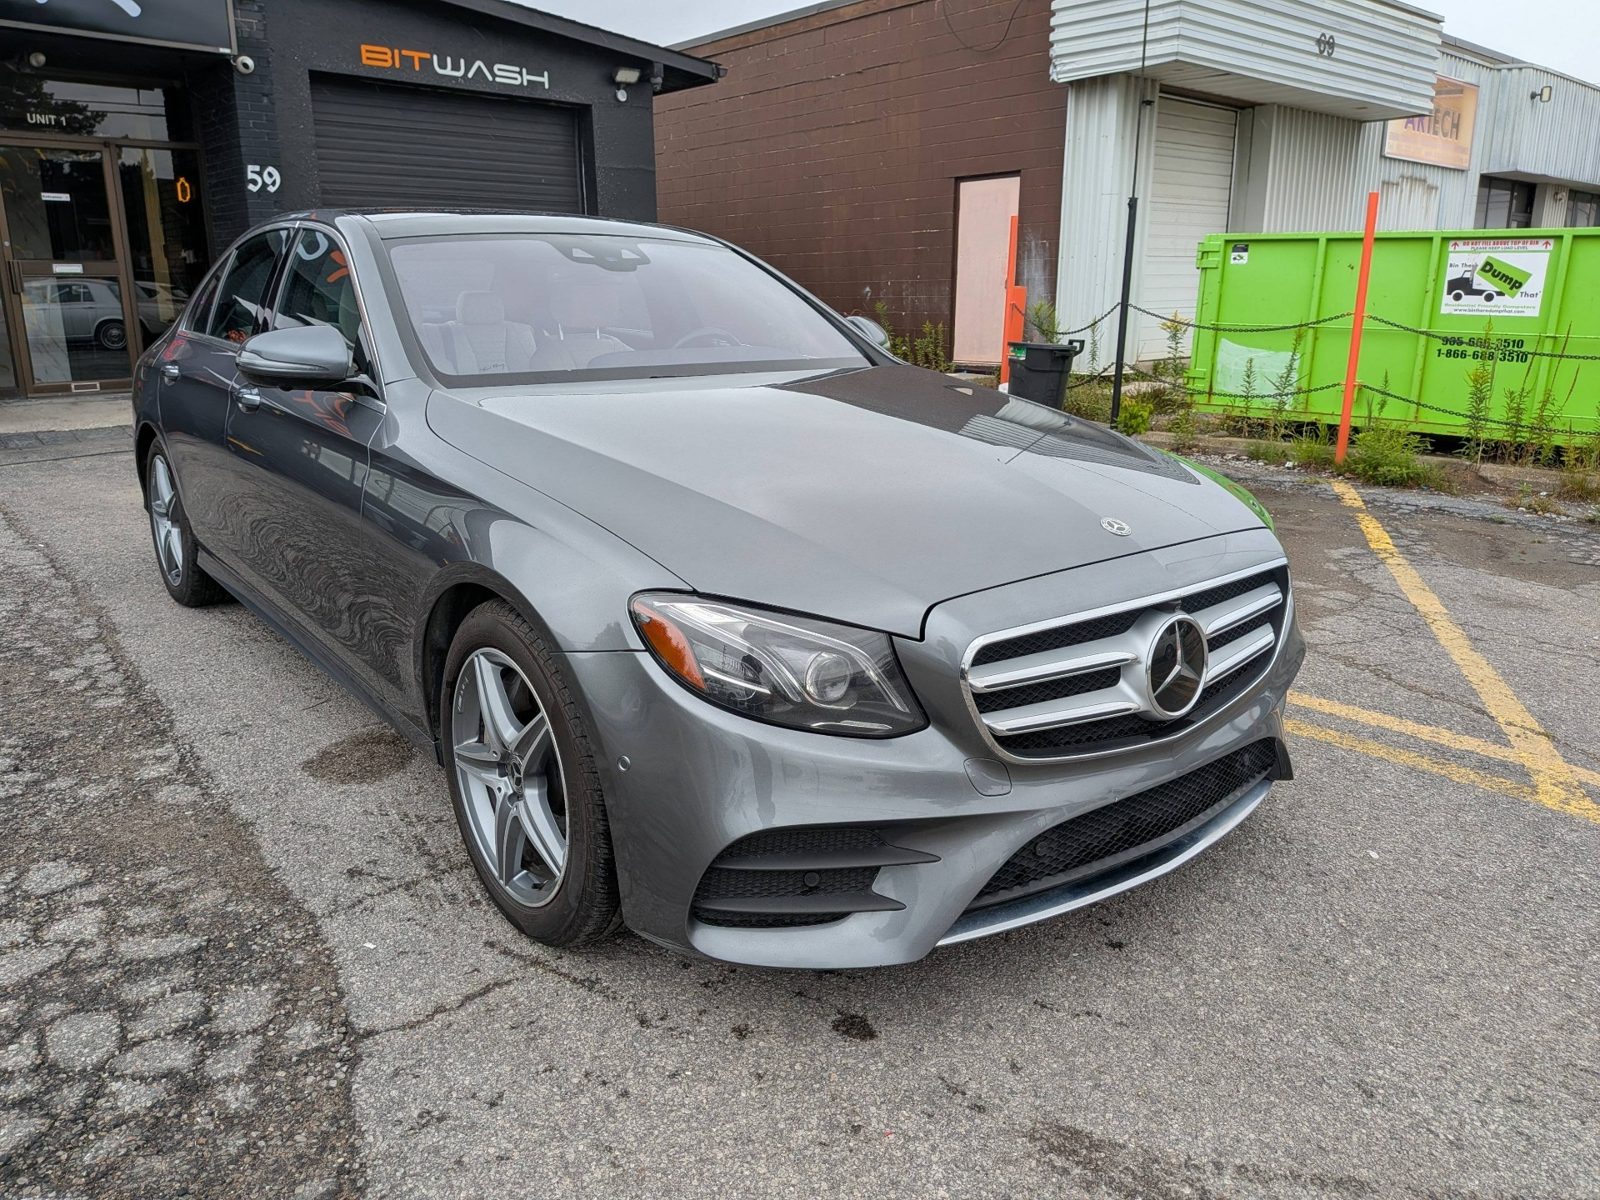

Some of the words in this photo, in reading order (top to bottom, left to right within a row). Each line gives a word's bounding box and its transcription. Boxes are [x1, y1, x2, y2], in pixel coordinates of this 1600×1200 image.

[360, 44, 549, 89] BITWASH
[27, 113, 57, 125] UNIT
[60, 116, 66, 126] 1
[247, 165, 281, 193] 59
[1480, 260, 1523, 291] Dump
